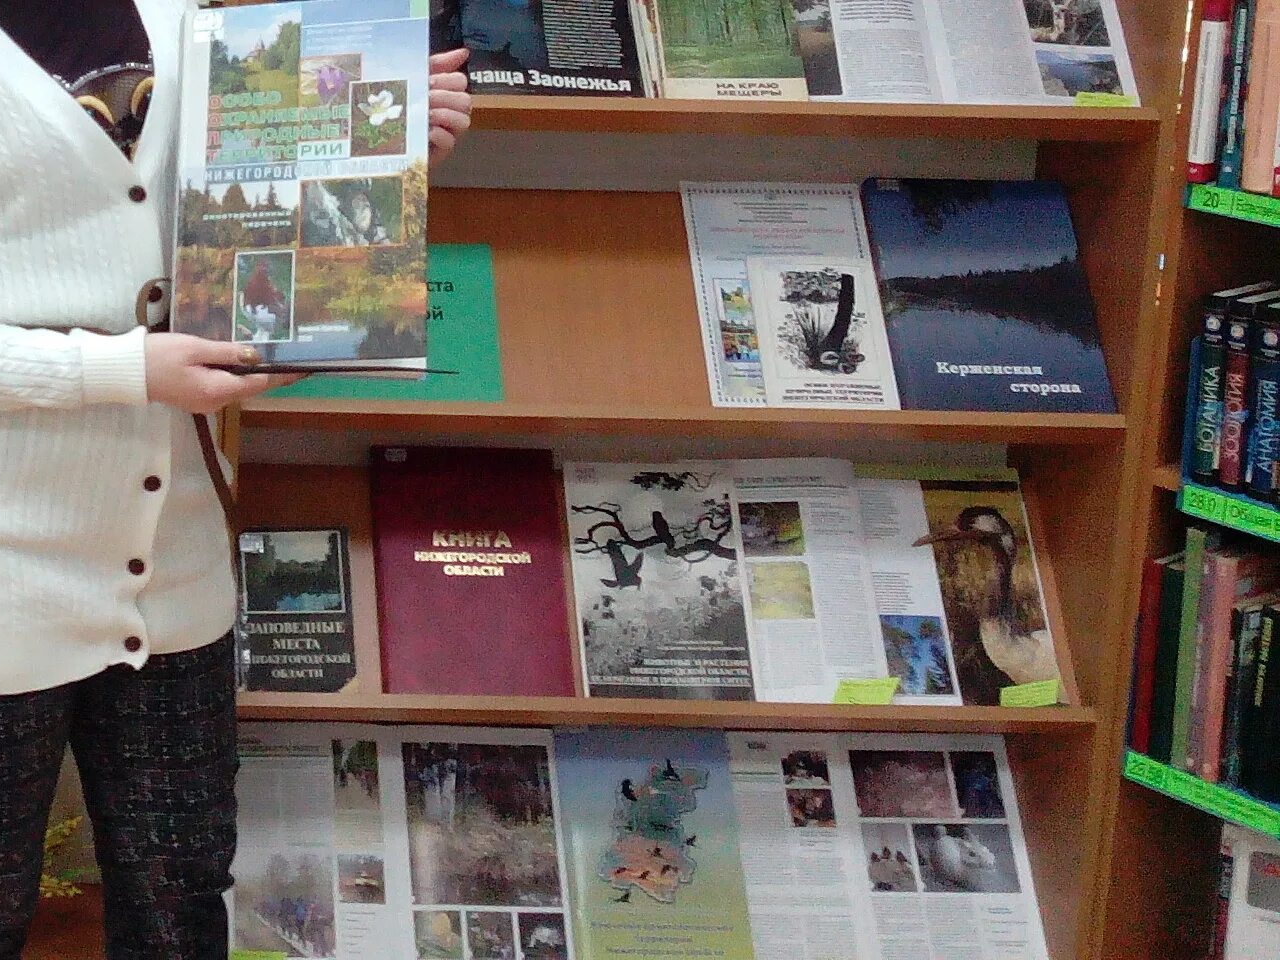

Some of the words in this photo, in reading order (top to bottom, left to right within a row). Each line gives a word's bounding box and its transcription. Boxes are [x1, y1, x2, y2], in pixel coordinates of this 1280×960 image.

[469, 71, 525, 89] чаща
[528, 69, 632, 92] Заонежья
[936, 361, 1043, 377] Керженская
[1010, 381, 1082, 395] сторона
[1258, 378, 1278, 472] АНАТОМИЯ
[432, 530, 512, 548] КНИГА
[414, 550, 532, 564] НИЖЕГОРОДСКОЙ
[444, 565, 505, 577] ОБЛАСТИ
[246, 621, 346, 634] ЗАПОВЕДНЫЕ
[271, 638, 322, 650] МЕСТА
